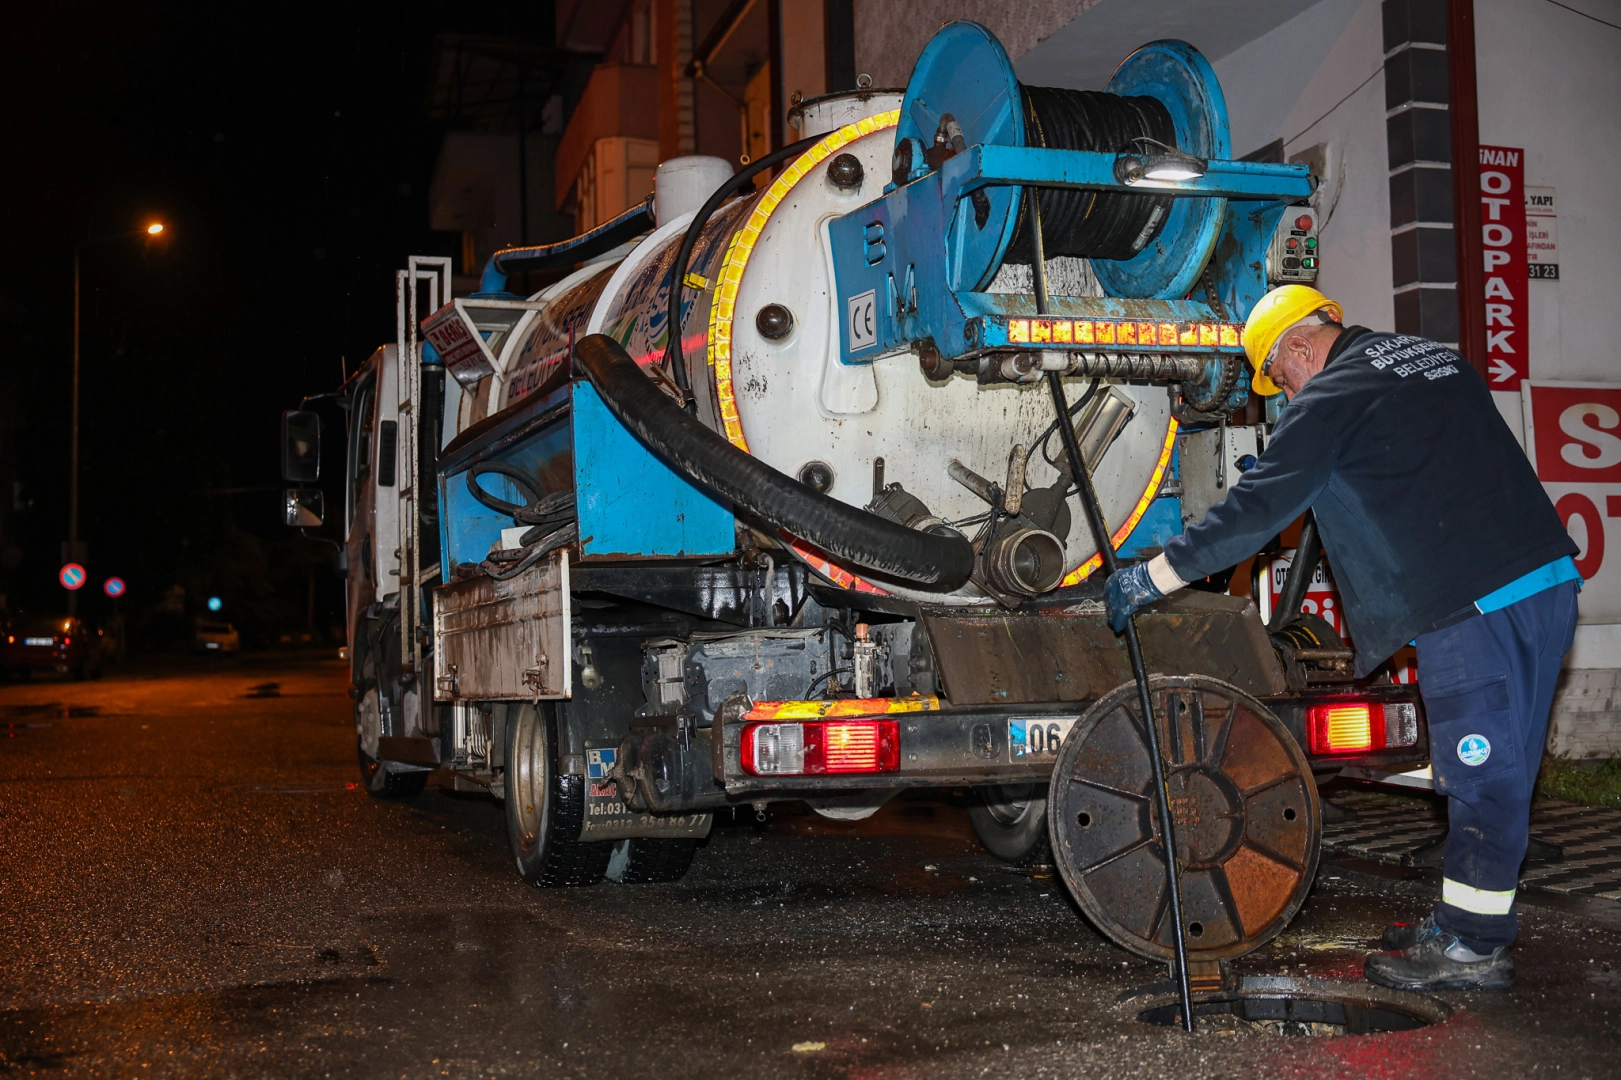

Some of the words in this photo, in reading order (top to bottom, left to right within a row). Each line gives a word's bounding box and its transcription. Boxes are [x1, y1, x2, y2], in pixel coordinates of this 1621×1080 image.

[1530, 196, 1553, 206] YAPI
[1480, 171, 1517, 354] OTOPARK
[1529, 265, 1541, 278] 31
[1543, 266, 1556, 278] 23
